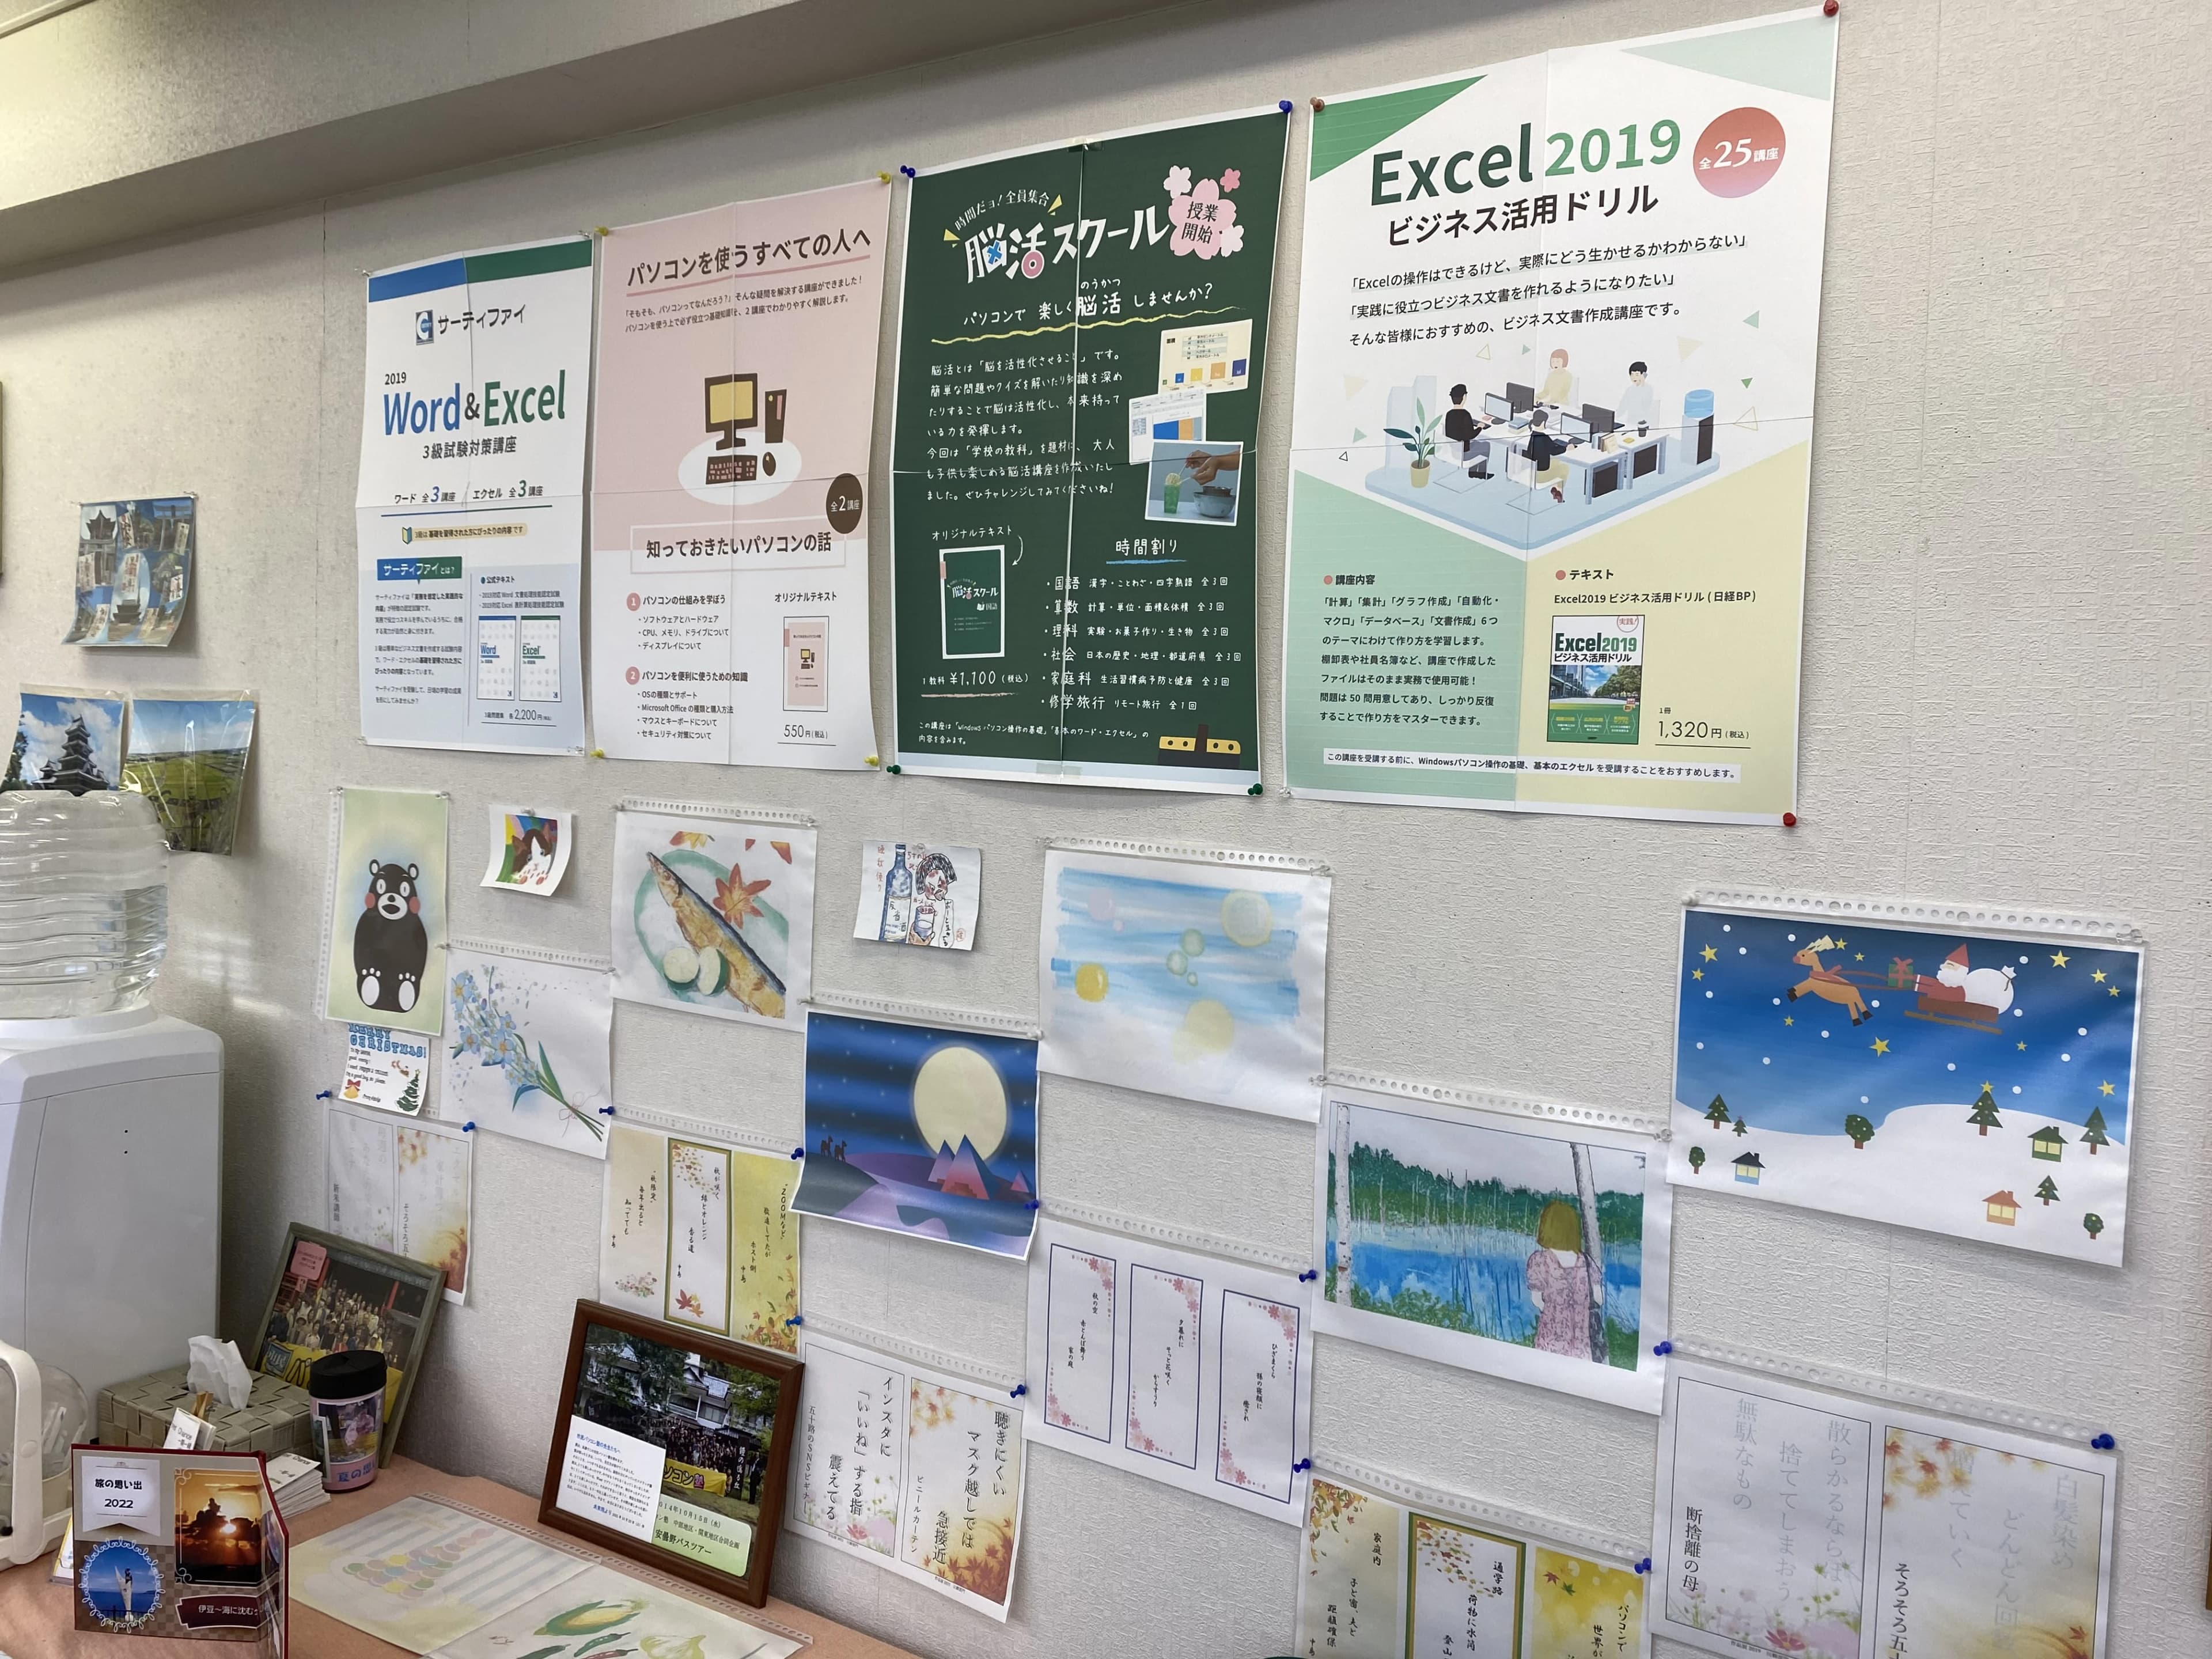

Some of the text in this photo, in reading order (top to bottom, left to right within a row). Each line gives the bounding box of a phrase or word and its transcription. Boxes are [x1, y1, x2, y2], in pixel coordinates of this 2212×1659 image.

[1371, 119, 1681, 206] Excel 2019
[1698, 138, 1779, 171] 全25講座
[1187, 201, 1219, 222] 授業
[1387, 185, 1659, 247] ビジネス活用ドリル
[1181, 222, 1214, 244] 開始
[964, 205, 1171, 283] 脳活スクール
[627, 229, 871, 286] パソコンを使うすべての人へ
[1081, 279, 1121, 290] のうかつ
[1351, 274, 1675, 319] 「実践に役立つビジネス文書を作れるようになりたい」
[438, 305, 526, 334] サーティファイ
[964, 309, 1026, 327] パソコンで
[1350, 301, 1681, 346] そんな皆様におすすめの、ビジネス文書作成講座です。
[385, 372, 406, 385] 2019
[927, 424, 1022, 437] いる力を発揮します。
[423, 436, 517, 459] 3級試験対策講座
[395, 493, 416, 503] ワード
[473, 488, 502, 499] エクセル
[831, 495, 860, 512] 全2講座
[932, 525, 1012, 541] オリジナルテキスト
[646, 532, 832, 559] 知っておきたいパソコンの話
[1116, 538, 1178, 556] 時間割り
[1335, 575, 1376, 585] 講座内容
[1570, 569, 1614, 580] テキスト
[1055, 577, 1080, 590] 国語
[643, 594, 725, 605] パソコンの仕組みを学ぼう
[775, 592, 836, 602] オリジナルテキスト
[952, 585, 999, 600] 脳活スクール
[1554, 594, 1606, 604] Excel2019
[1609, 593, 1705, 603] ビジネス活用ドリル
[1054, 599, 1078, 615] 算数
[643, 615, 719, 623] ソフトウェアとハードウェア
[1052, 623, 1078, 638] 理科
[1322, 636, 1484, 646] のテーマにわけて作り方を学習します。
[480, 645, 496, 654] Word
[522, 646, 540, 655] Excel
[1051, 647, 1076, 662] 社会
[1321, 654, 1496, 666] 棚卸表や社員名簿など、講座で作成した
[1554, 654, 1632, 662] ビジネス活用ドリル
[642, 671, 748, 682] パソコンを便利に使うための知識
[1051, 671, 1092, 686] 家庭科
[642, 704, 669, 712] Microsoft
[1050, 695, 1105, 710] 修学旅行
[642, 717, 717, 726] マウスとキーボードについて
[1320, 711, 1480, 726] することで作り方をマスターできます。
[642, 730, 711, 740] セキュリティ対策について
[919, 734, 967, 745] 内容を含みます。
[350, 1034, 426, 1058] CHRISTMAS!
[880, 1377, 893, 1457] インスタに
[993, 1411, 1009, 1496] 聴きにくい
[1733, 1398, 1758, 1510] 無駄なもの
[95, 1479, 142, 1490] 旅の思い出
[826, 1453, 842, 1521] 震えてる
[962, 1430, 980, 1548] マスク越しでは
[104, 1499, 133, 1508] 2022
[1823, 1420, 1852, 1583] 散らかるならば
[1776, 1441, 1802, 1602] 捨ててしまおう
[933, 1510, 949, 1564] 急接近
[1373, 1533, 1382, 1566] 家庭内
[1682, 1506, 1703, 1592] 断捨離の母
[1492, 1560, 1505, 1596] 通学路
[1327, 1604, 1336, 1647] 距離確保
[1467, 1594, 1478, 1651] 荷物に水筒
[1443, 1635, 1453, 1659] 登山
[1592, 1624, 1603, 1657] 世界が
